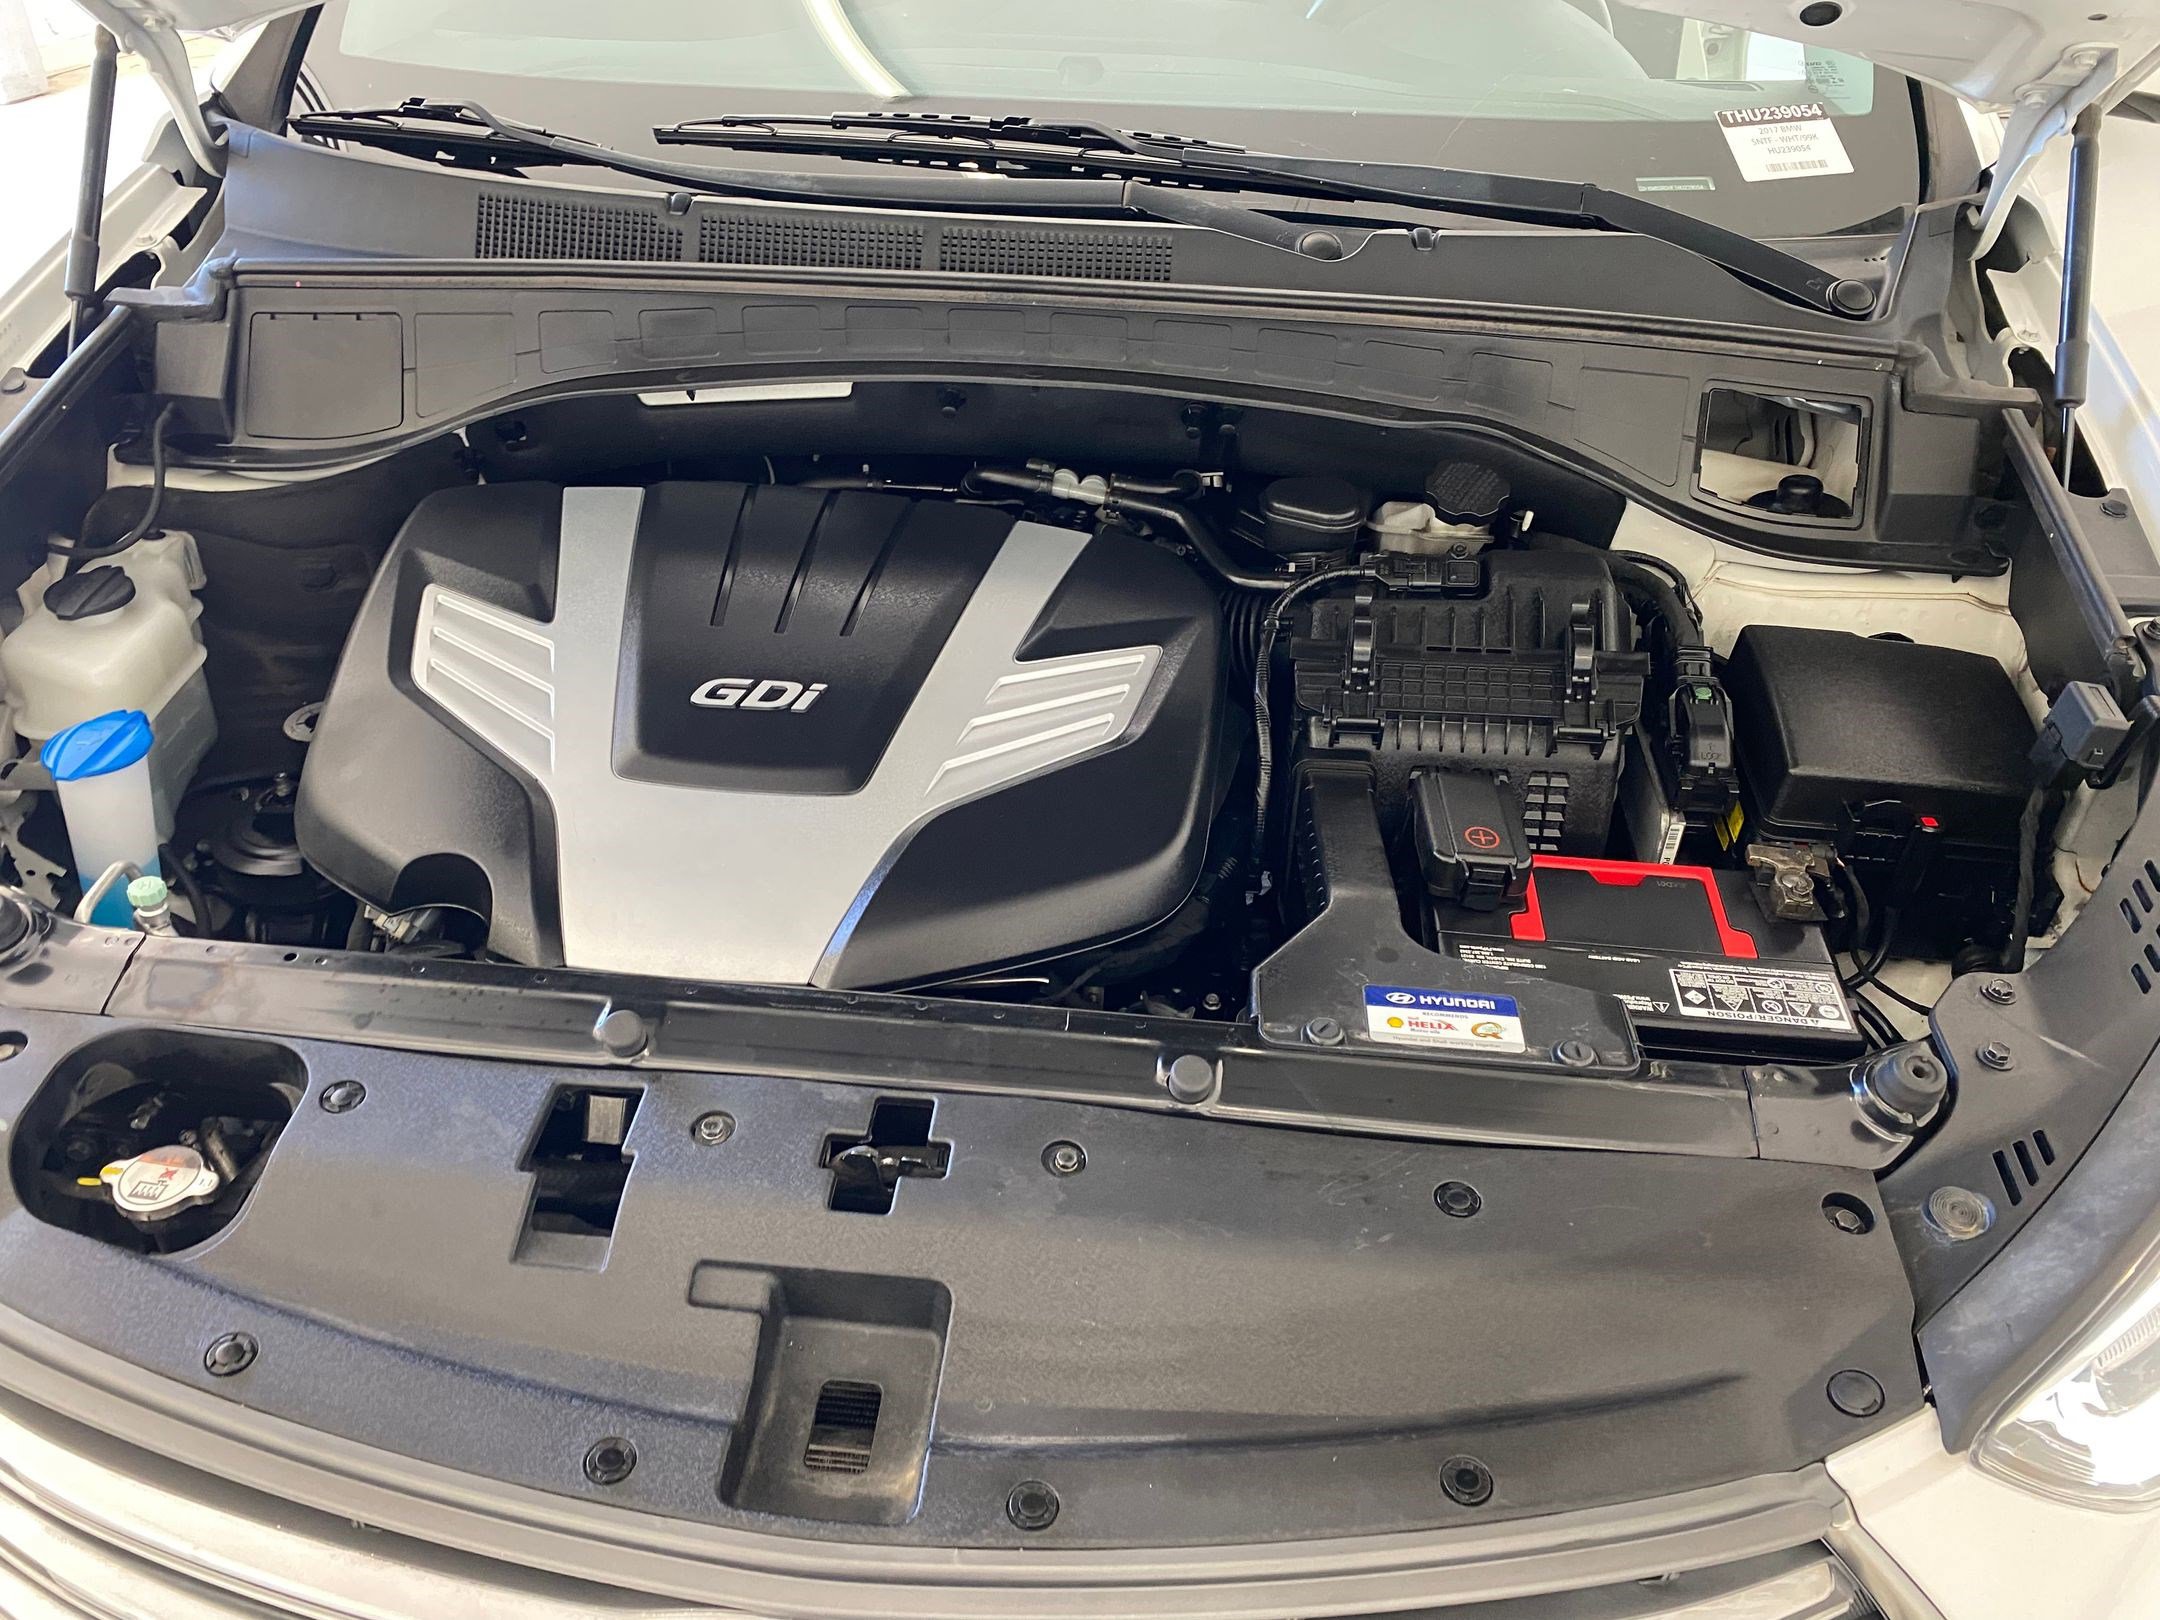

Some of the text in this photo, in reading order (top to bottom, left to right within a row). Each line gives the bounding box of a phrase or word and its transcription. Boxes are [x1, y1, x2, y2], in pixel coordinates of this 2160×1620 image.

[1722, 103, 1823, 124] THU239054
[1758, 124, 1802, 135] 2017 BMW
[1751, 137, 1772, 146] SNTF
[1767, 144, 1811, 154] HU239054
[689, 677, 829, 713] GDi
[1419, 995, 1496, 1010] HYUNDAI
[1422, 1011, 1469, 1019] RECOMMENDS
[1707, 1010, 1808, 1024] DANGER/POISON
[1408, 1020, 1457, 1031] HELIX
